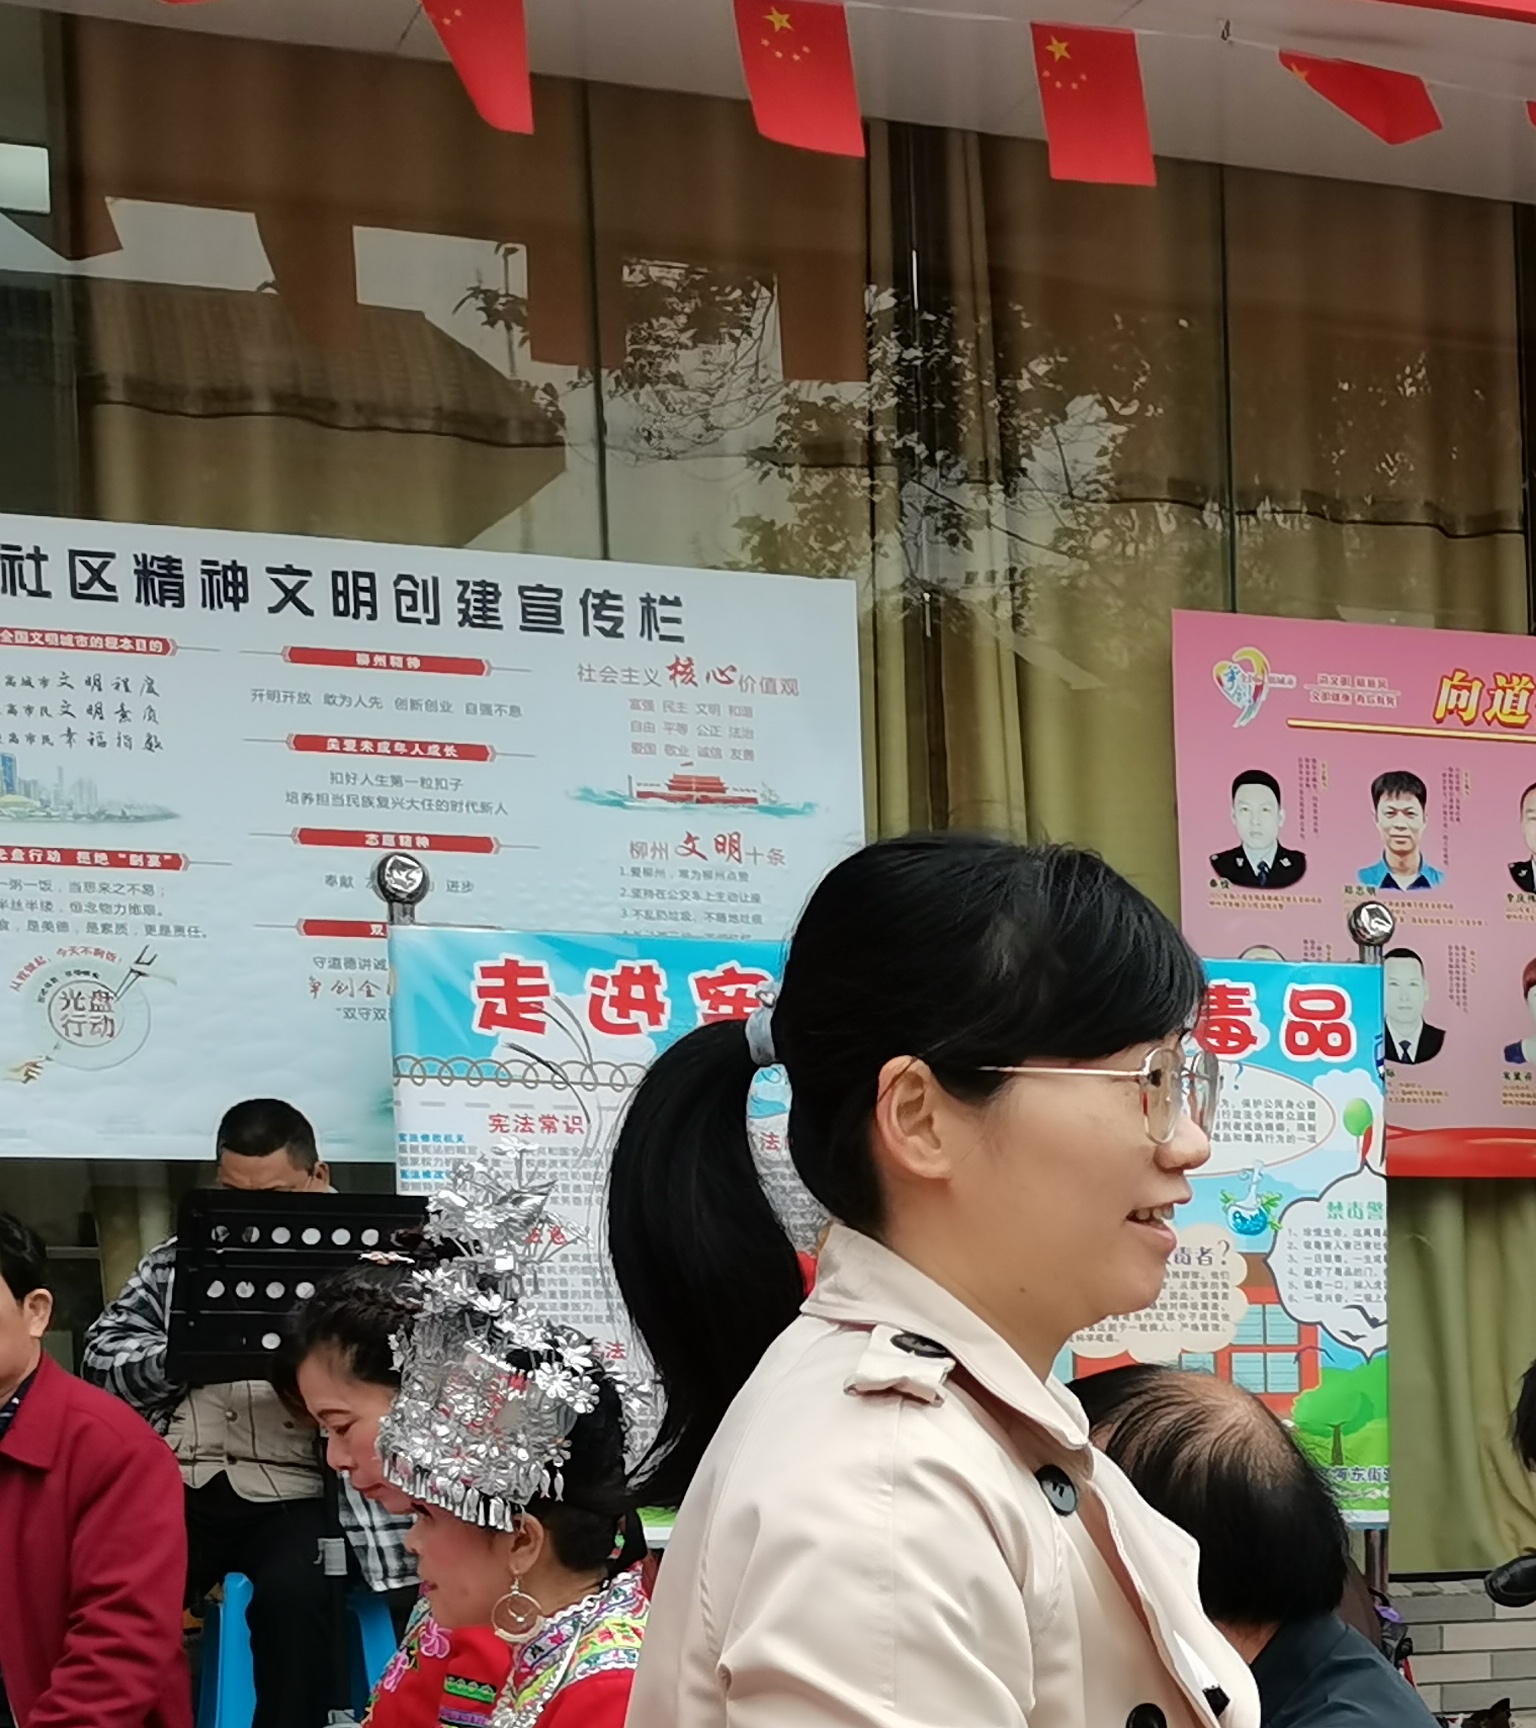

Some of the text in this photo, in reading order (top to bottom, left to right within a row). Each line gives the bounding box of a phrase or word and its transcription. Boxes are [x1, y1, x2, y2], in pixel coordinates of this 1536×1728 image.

[0, 545, 684, 643] 社区精神文明创建宣传栏
[577, 655, 800, 697] 社会主义核心价值观
[250, 688, 523, 718] 开明开放 敢为人先 创新创业 自强不息
[695, 702, 722, 717] 文明
[630, 720, 656, 734] 自由
[696, 724, 723, 738] 公正
[329, 771, 464, 792] 扣好人生第一粒扣子
[285, 791, 509, 816] 培养担当民族复兴大任的时代新人
[629, 830, 787, 867] 柳州文明十条
[446, 878, 475, 893] 进步
[60, 988, 115, 1013] 光盘
[60, 1012, 116, 1038] 行动
[335, 1006, 393, 1021] “双守双
[1199, 985, 1352, 1057] 毒品
[487, 1113, 586, 1136] 宪法常识
